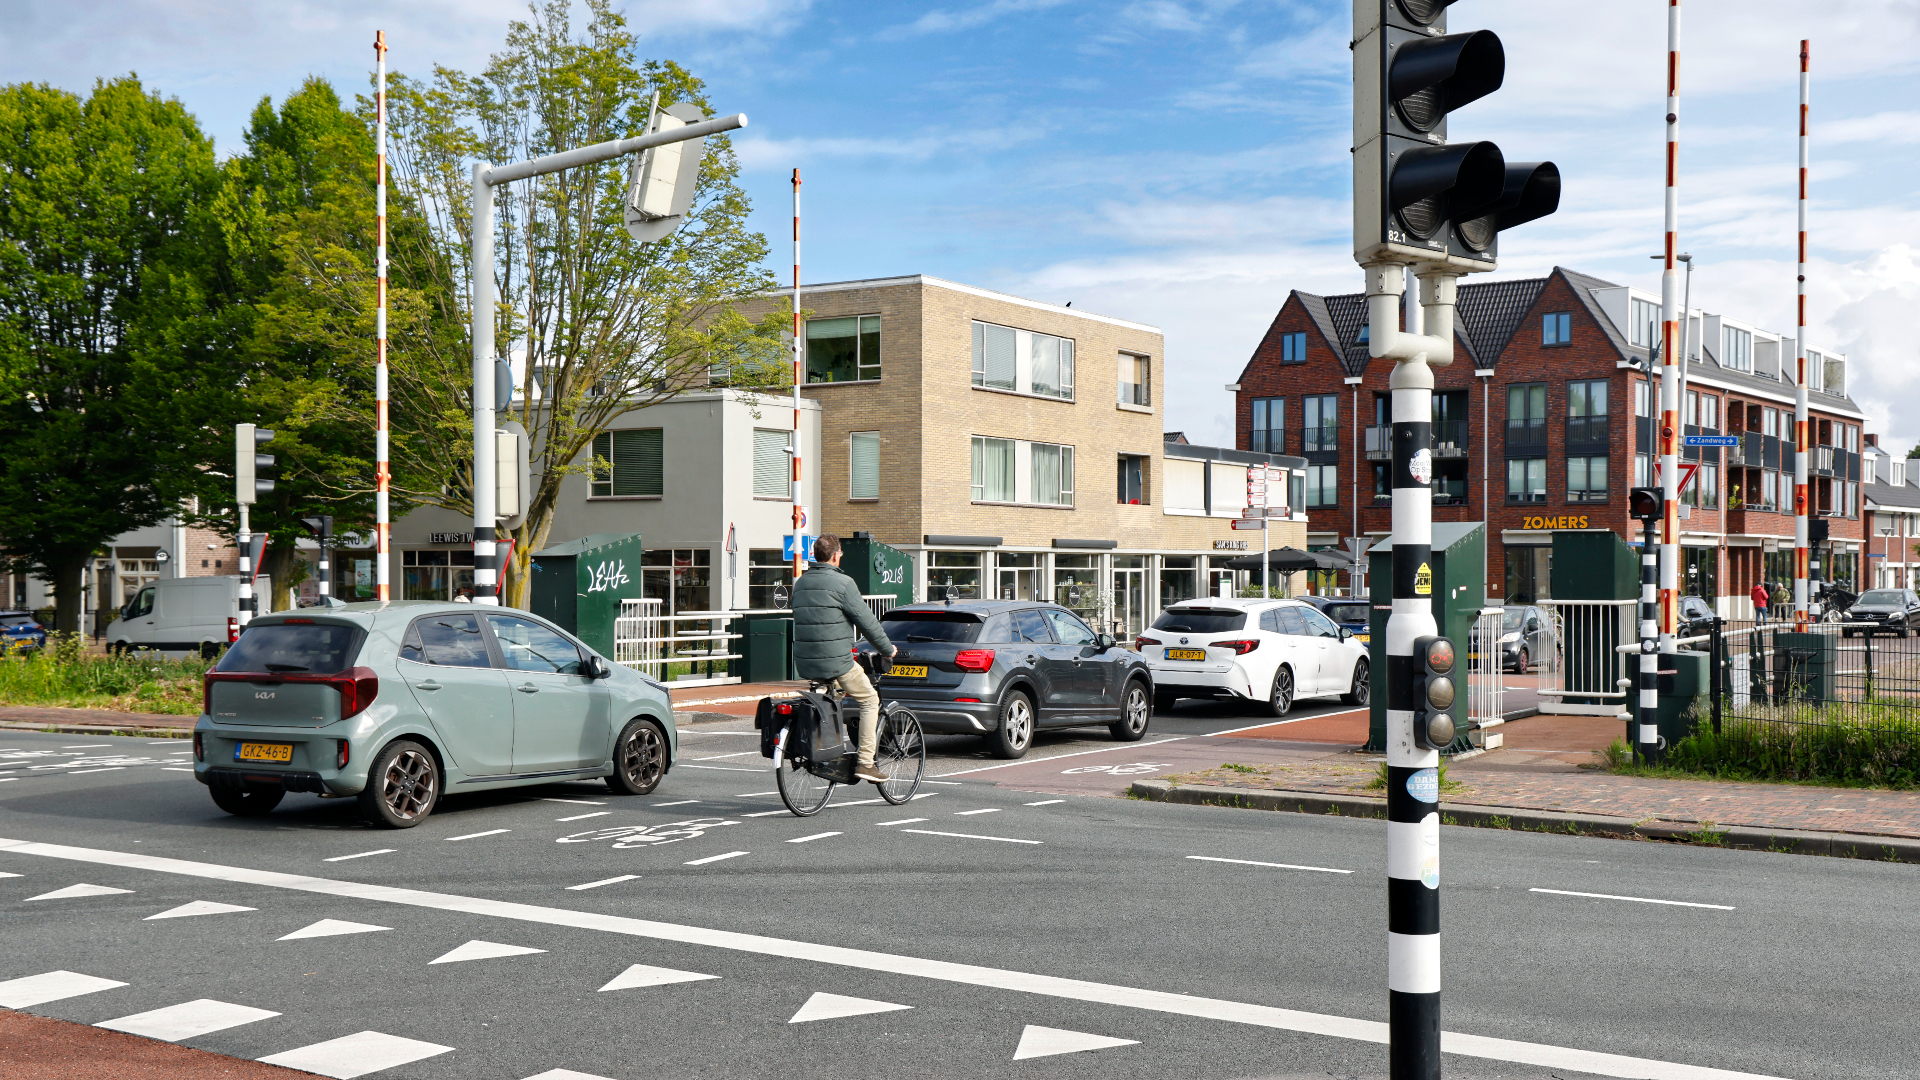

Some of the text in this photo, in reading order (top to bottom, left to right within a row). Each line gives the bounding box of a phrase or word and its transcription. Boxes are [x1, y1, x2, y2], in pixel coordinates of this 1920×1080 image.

[1388, 230, 1406, 243] 82.1
[1523, 516, 1588, 529] ZOMERS
[429, 533, 474, 543] LEEWIS TW
[887, 666, 924, 676] V-827-X
[243, 744, 289, 759] GKZ-46-B
